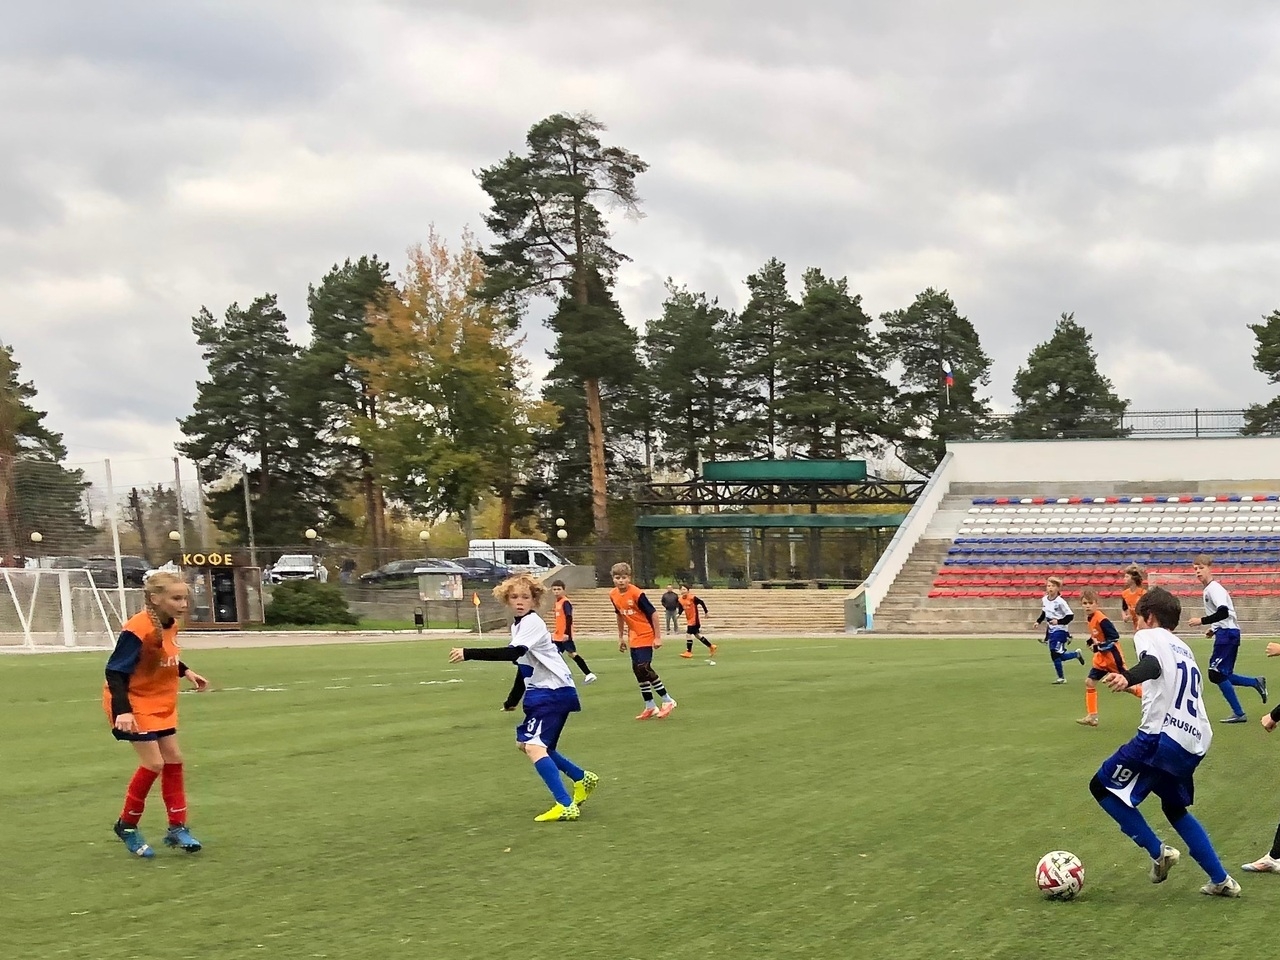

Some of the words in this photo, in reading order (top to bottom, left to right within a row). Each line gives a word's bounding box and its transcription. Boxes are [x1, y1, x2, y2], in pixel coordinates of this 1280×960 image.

[182, 552, 234, 566] КОФЕ
[1174, 660, 1201, 718] 19
[1111, 764, 1133, 782] 19
